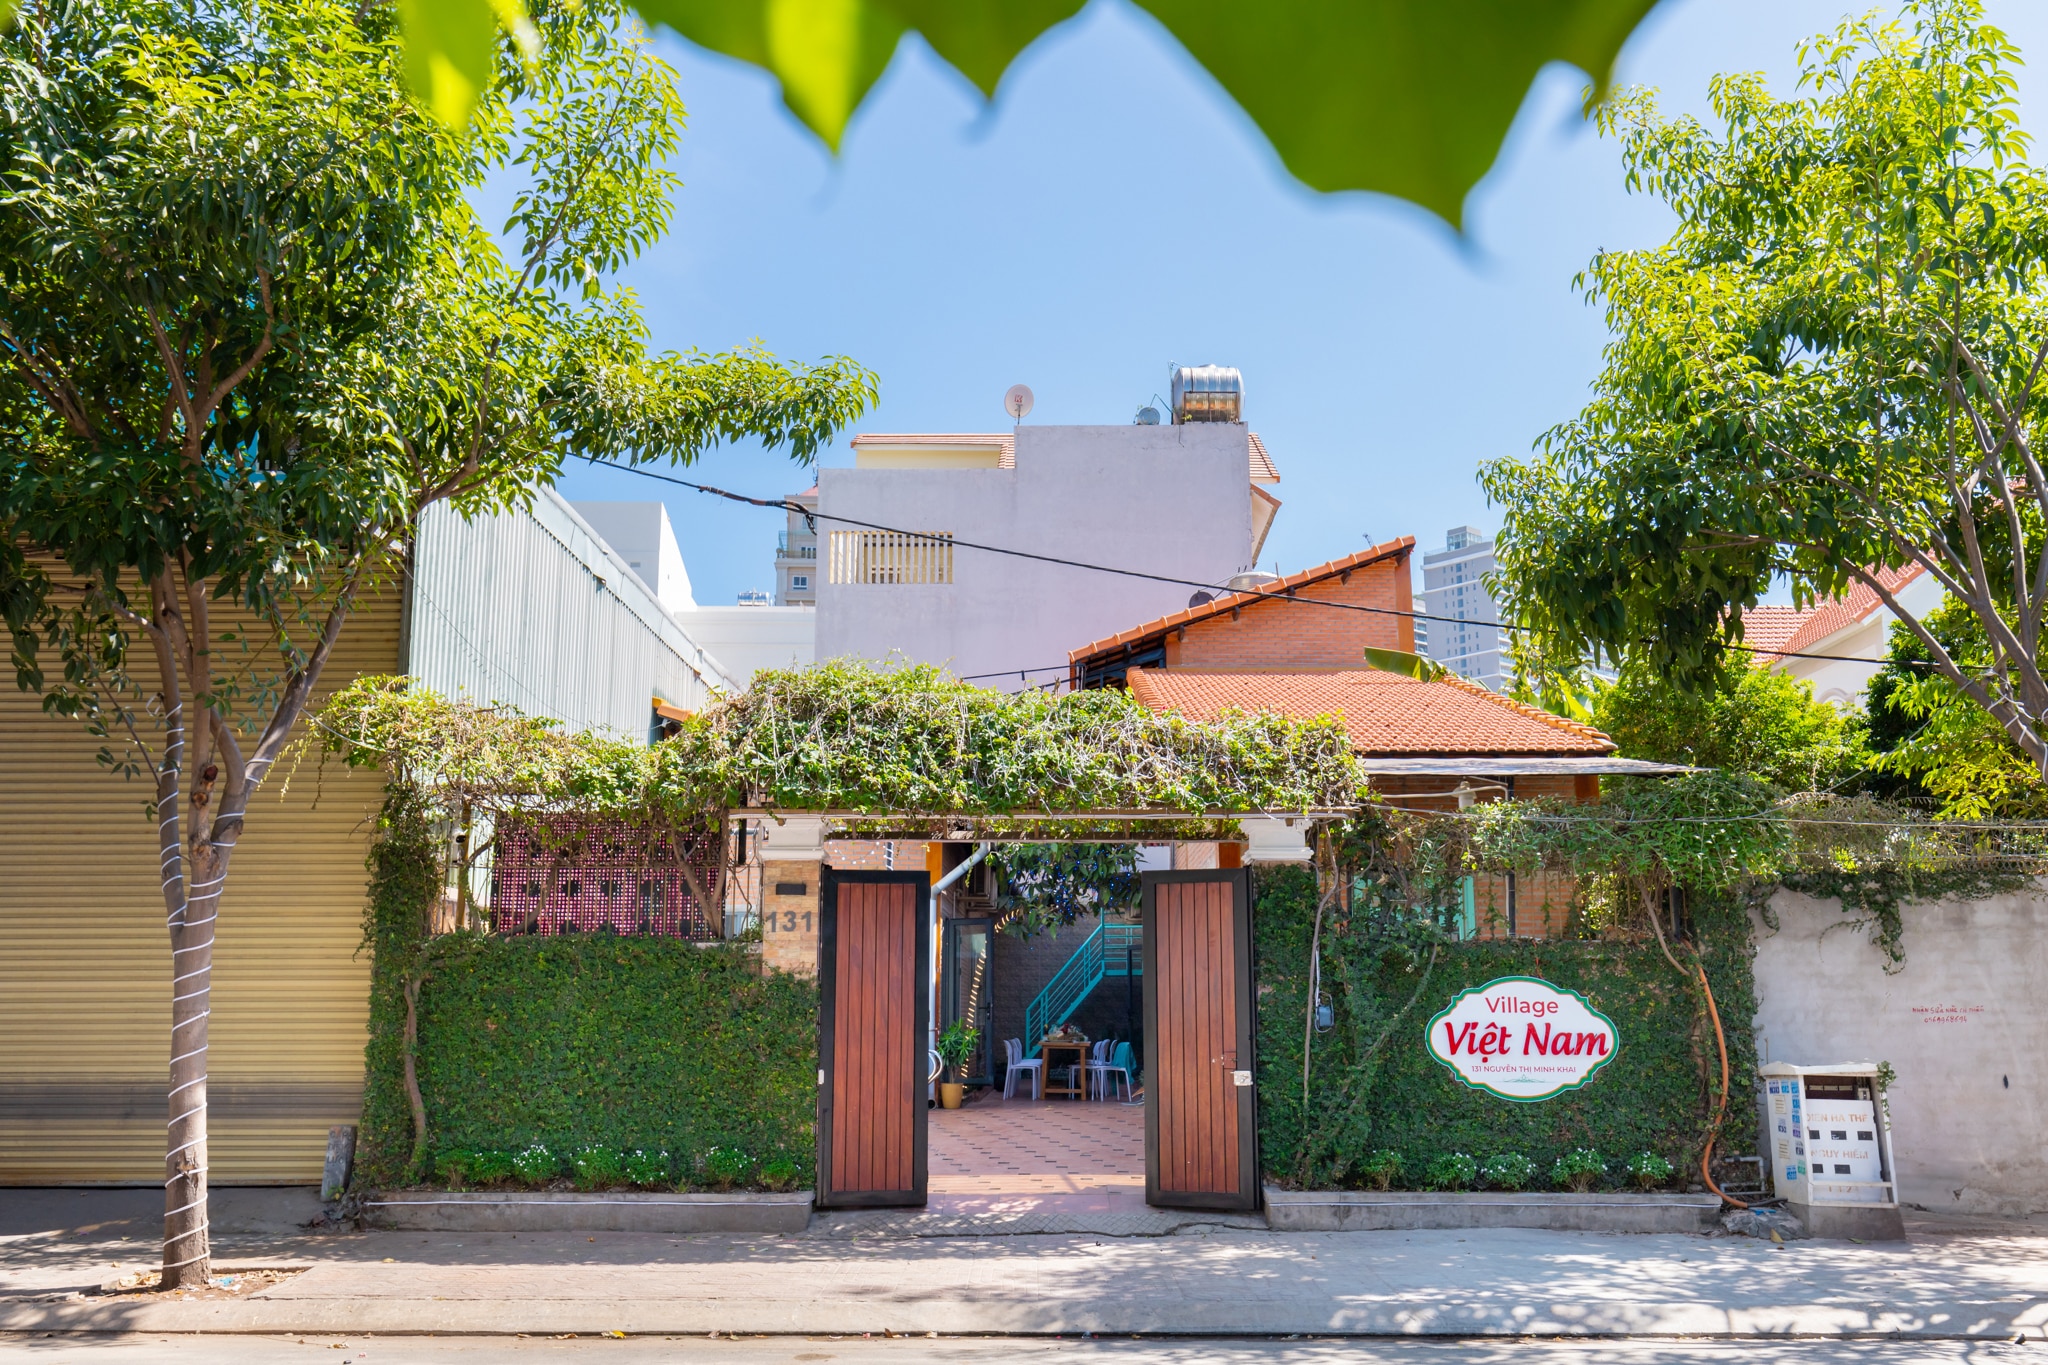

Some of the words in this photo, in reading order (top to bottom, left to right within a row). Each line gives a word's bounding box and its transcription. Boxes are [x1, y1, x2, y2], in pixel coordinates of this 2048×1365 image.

[766, 911, 811, 932] 131
[1485, 996, 1559, 1017] Village
[1444, 1022, 1512, 1063] Việt
[1523, 1022, 1609, 1056] Nam
[1471, 1065, 1482, 1073] 131
[1483, 1063, 1517, 1073] NGUYỄN
[1519, 1065, 1532, 1074] THỊ
[1533, 1065, 1555, 1073] MINH
